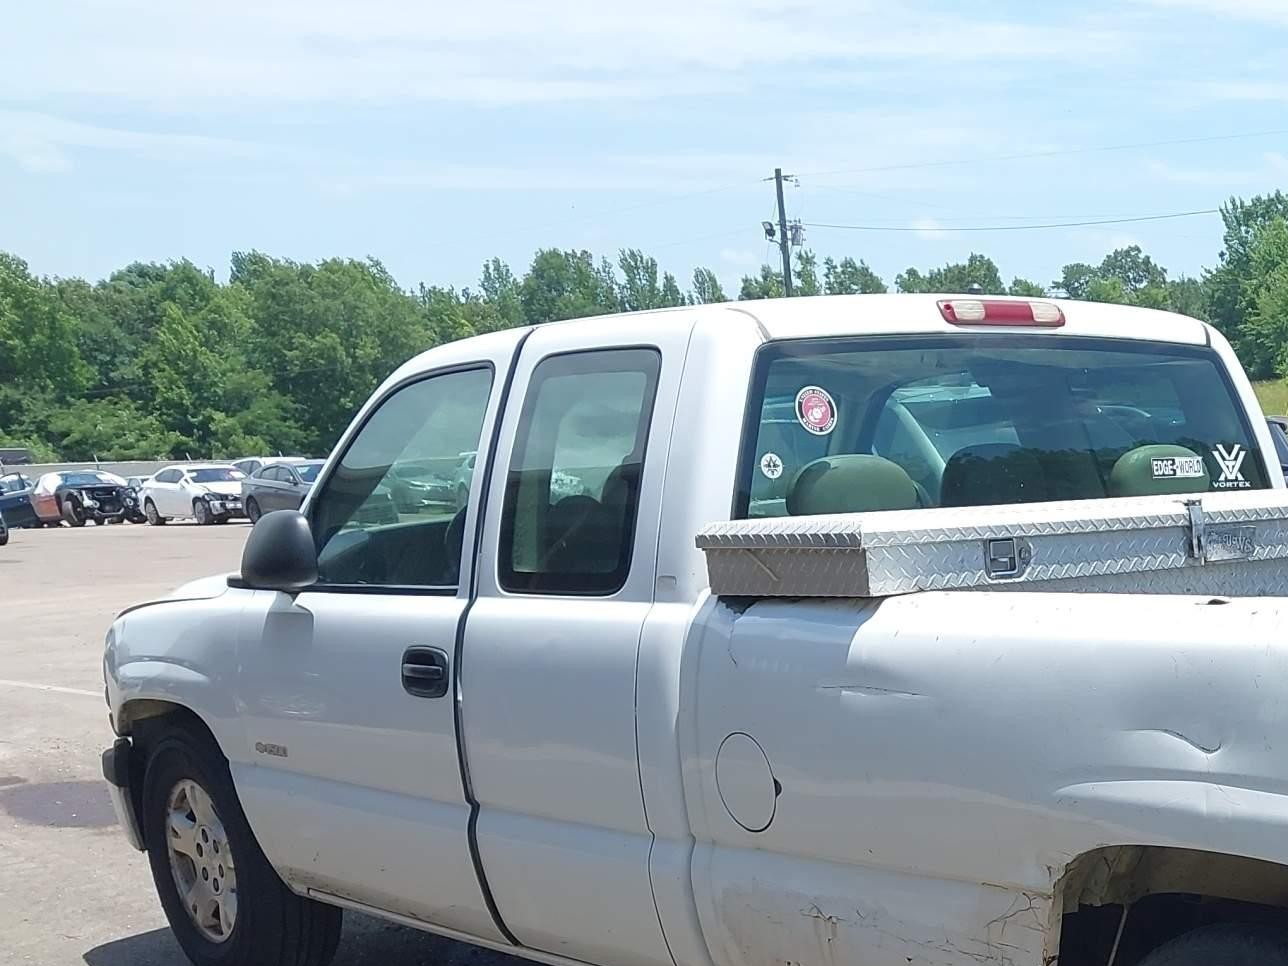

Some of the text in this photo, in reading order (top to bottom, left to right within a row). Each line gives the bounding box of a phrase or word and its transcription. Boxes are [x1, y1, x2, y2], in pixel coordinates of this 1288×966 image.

[1153, 459, 1202, 476] EDGE WORLD
[1212, 480, 1252, 489] VORTEX
